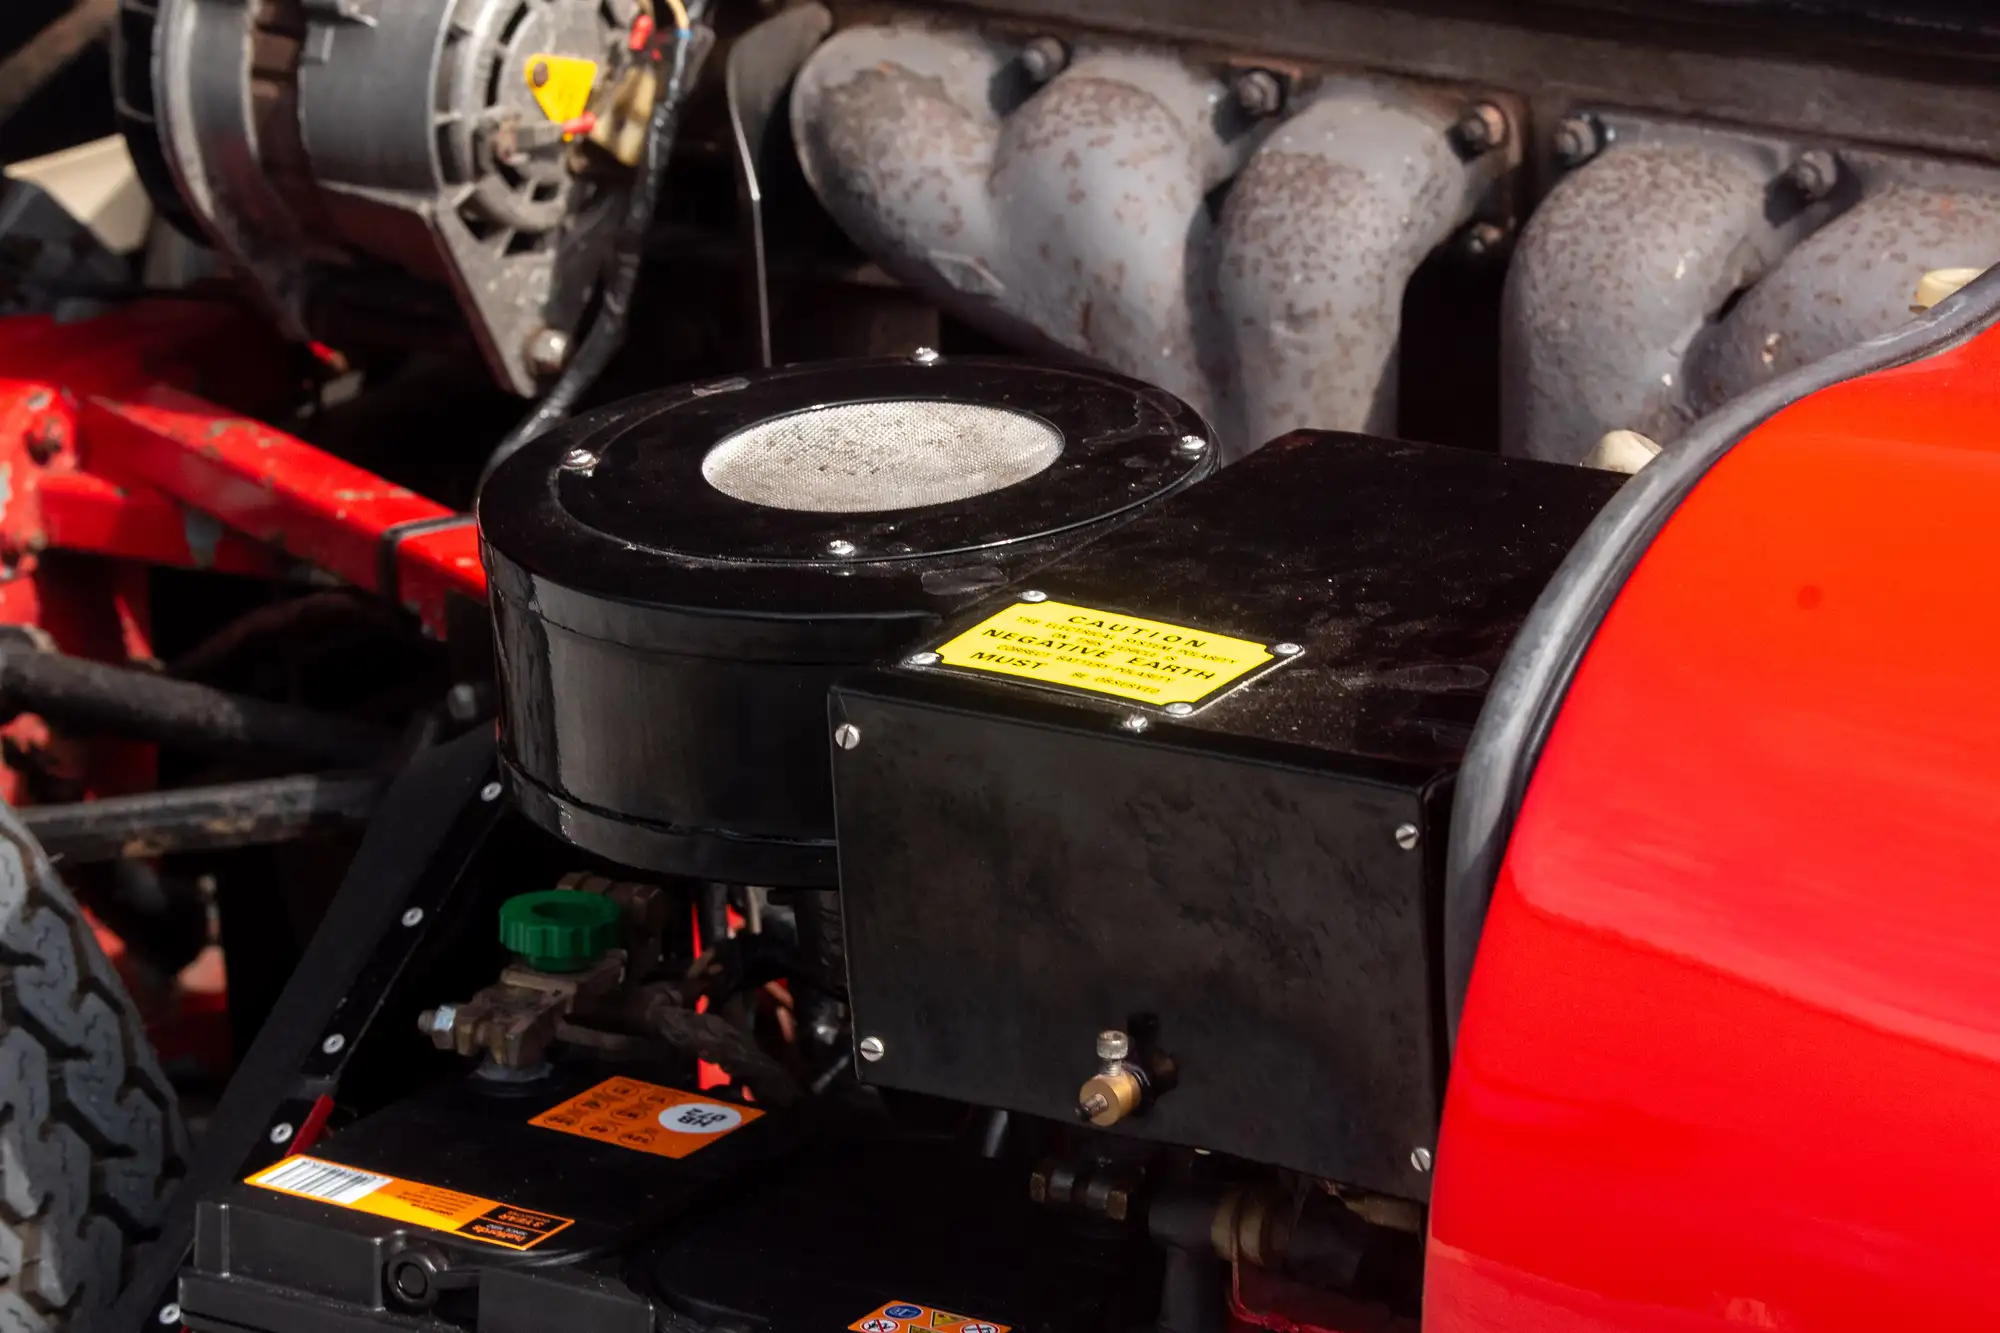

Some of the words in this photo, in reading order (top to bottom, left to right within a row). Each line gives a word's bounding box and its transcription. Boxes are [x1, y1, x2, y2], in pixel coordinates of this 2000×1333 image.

[1016, 616, 1042, 625] THE
[1045, 622, 1117, 640] ELECTRICAL
[1122, 638, 1173, 650] SYSTEM
[1177, 649, 1239, 664] POLARITY
[1068, 616, 1208, 648] CAUTION
[970, 652, 1048, 669] MUST
[1094, 676, 1160, 694] OBSERVED
[982, 629, 1114, 659] NEGATIVE
[1128, 657, 1216, 680] EARTH
[1056, 655, 1113, 669] BATTERY
[1113, 667, 1175, 682] POLARITY
[677, 1115, 713, 1128] HB
